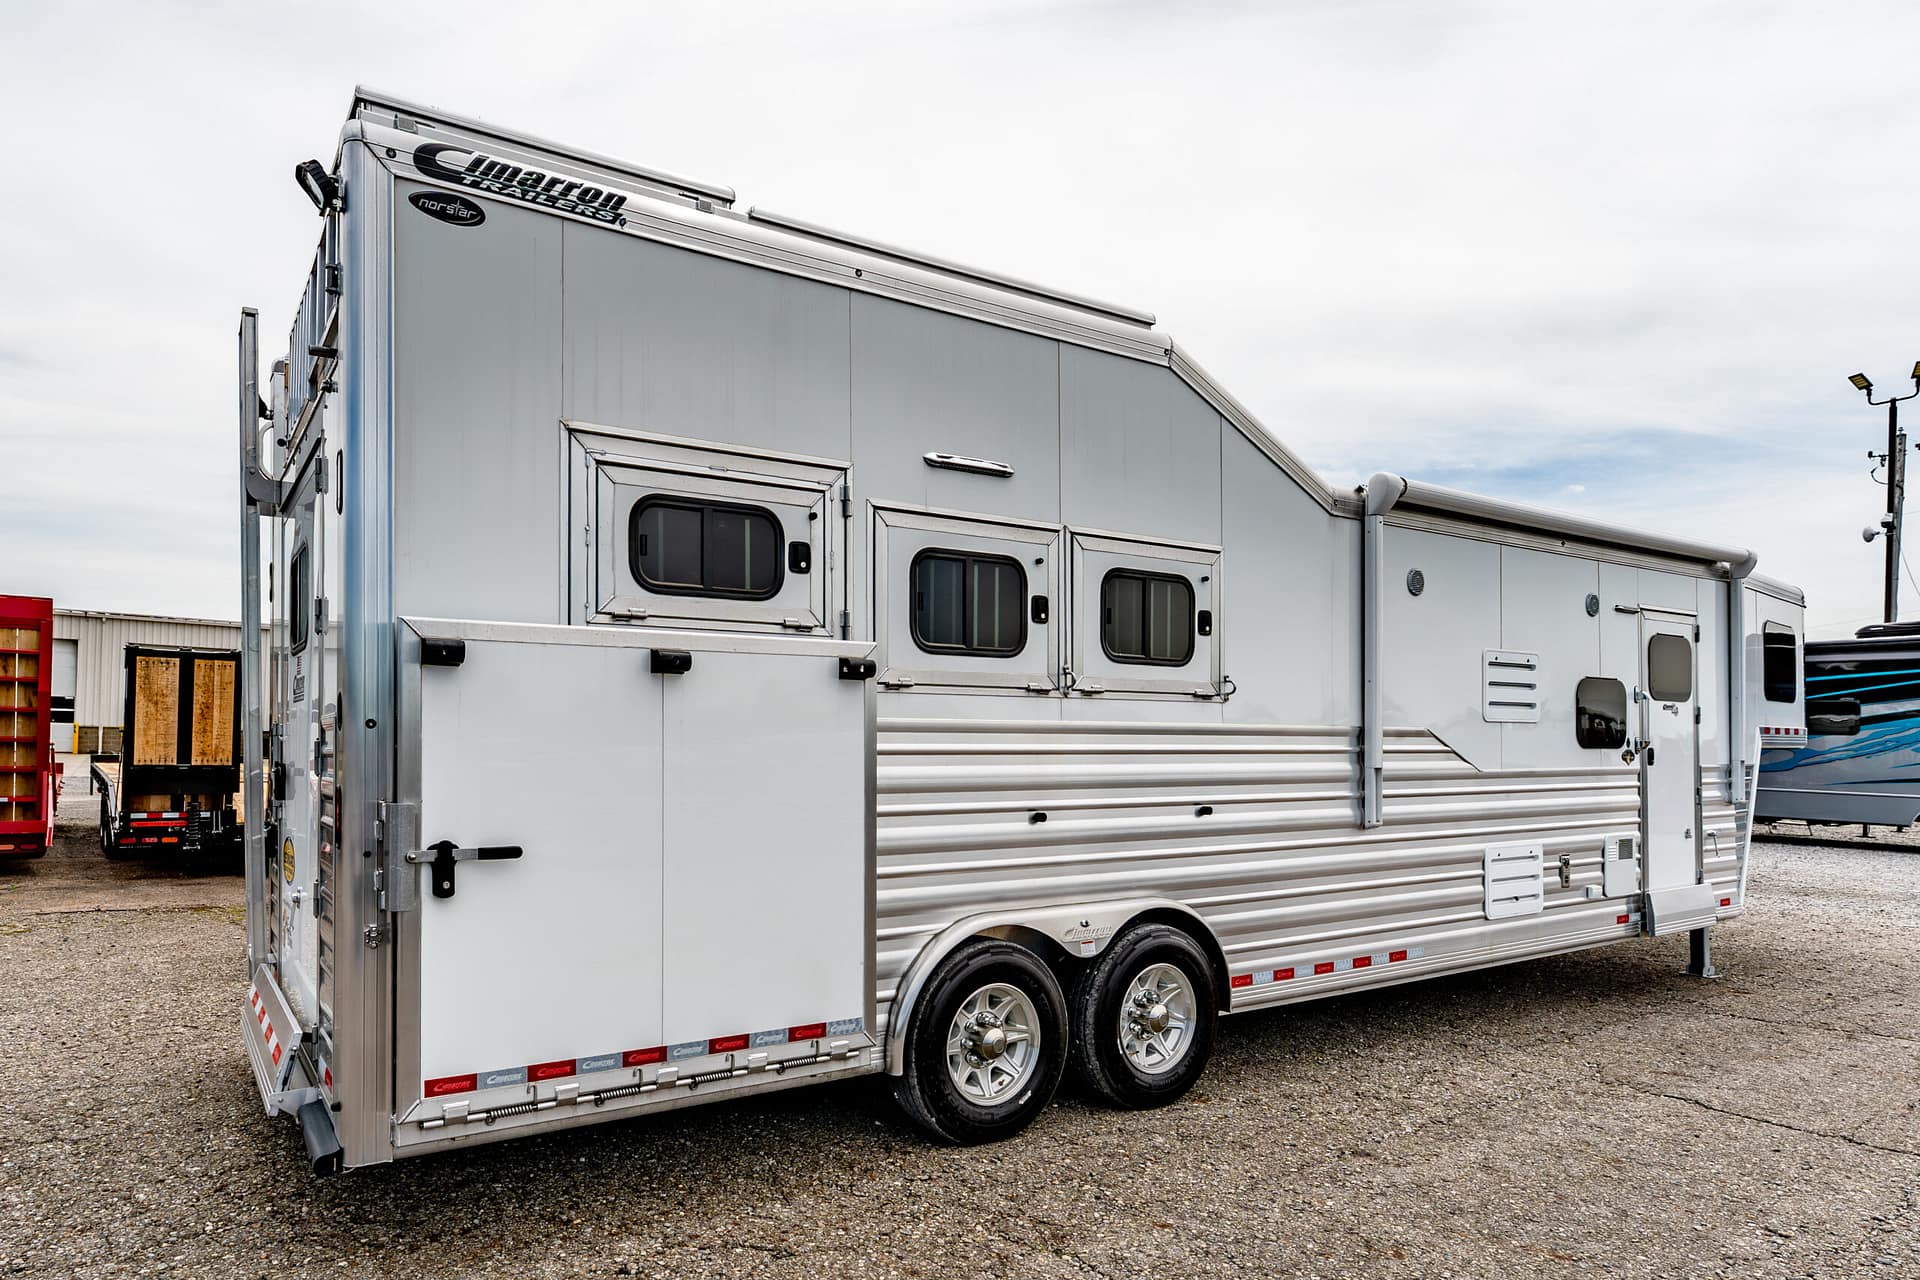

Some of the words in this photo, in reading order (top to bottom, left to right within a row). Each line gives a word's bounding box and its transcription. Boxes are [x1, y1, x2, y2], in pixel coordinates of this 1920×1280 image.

[412, 143, 627, 211] Cimarron
[460, 173, 615, 221] TRAILERS
[418, 199, 477, 219] norstar
